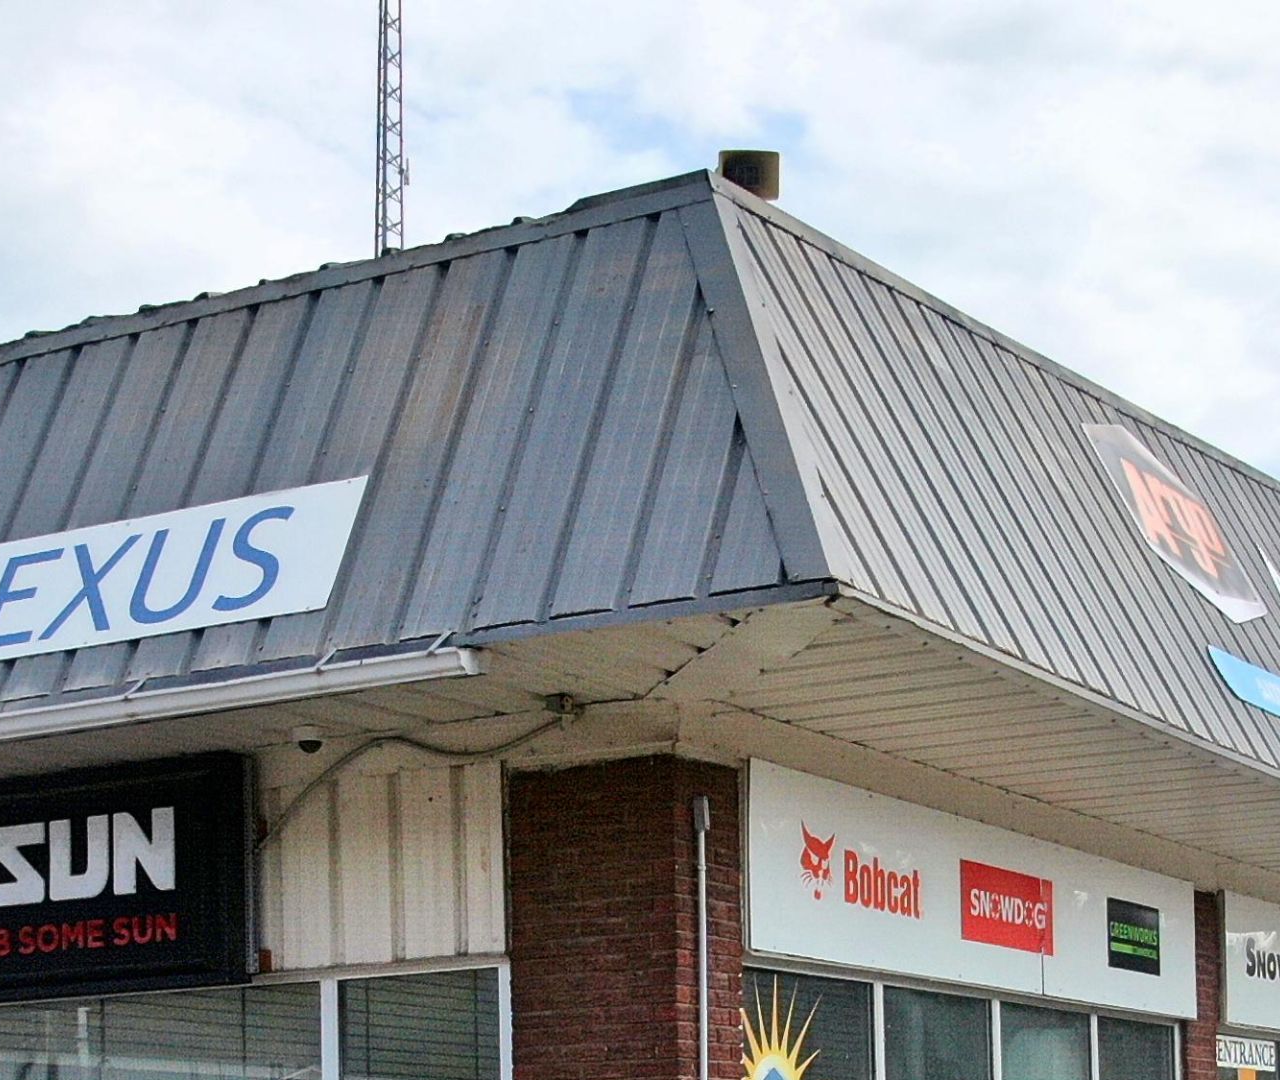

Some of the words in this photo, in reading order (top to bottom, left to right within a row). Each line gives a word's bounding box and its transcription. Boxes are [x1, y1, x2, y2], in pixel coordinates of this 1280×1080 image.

[844, 849, 921, 919] Bobcat
[19, 919, 105, 955] SOME
[114, 913, 178, 946] SUN
[1217, 1038, 1275, 1067] ENTRANCE
